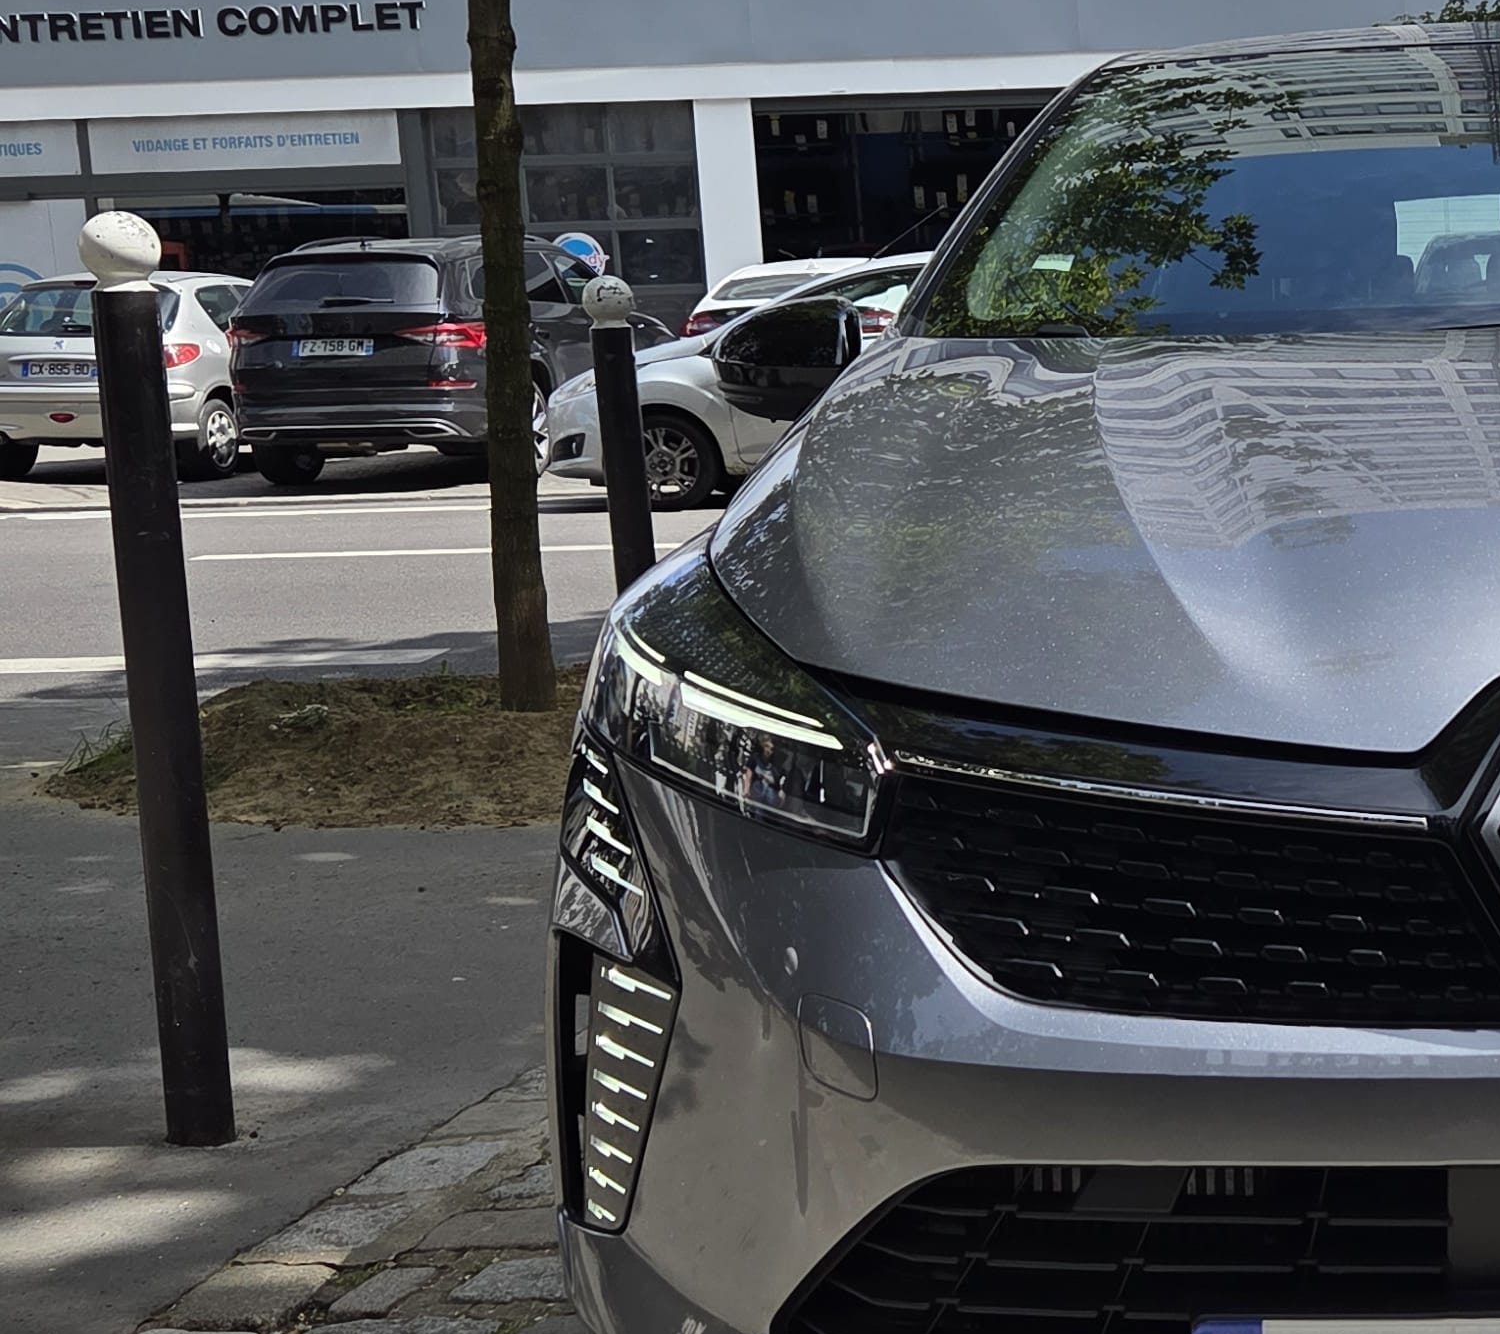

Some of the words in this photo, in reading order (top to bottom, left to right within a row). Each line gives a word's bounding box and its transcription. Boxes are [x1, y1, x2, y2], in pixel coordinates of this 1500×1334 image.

[0, 9, 204, 43] NTRETIEN
[217, 0, 426, 37] COMPLET
[132, 138, 189, 152] VIDANGE
[193, 137, 208, 150] ET
[212, 135, 274, 149] FORFAITS
[277, 131, 360, 147] D'ENTRETIEN
